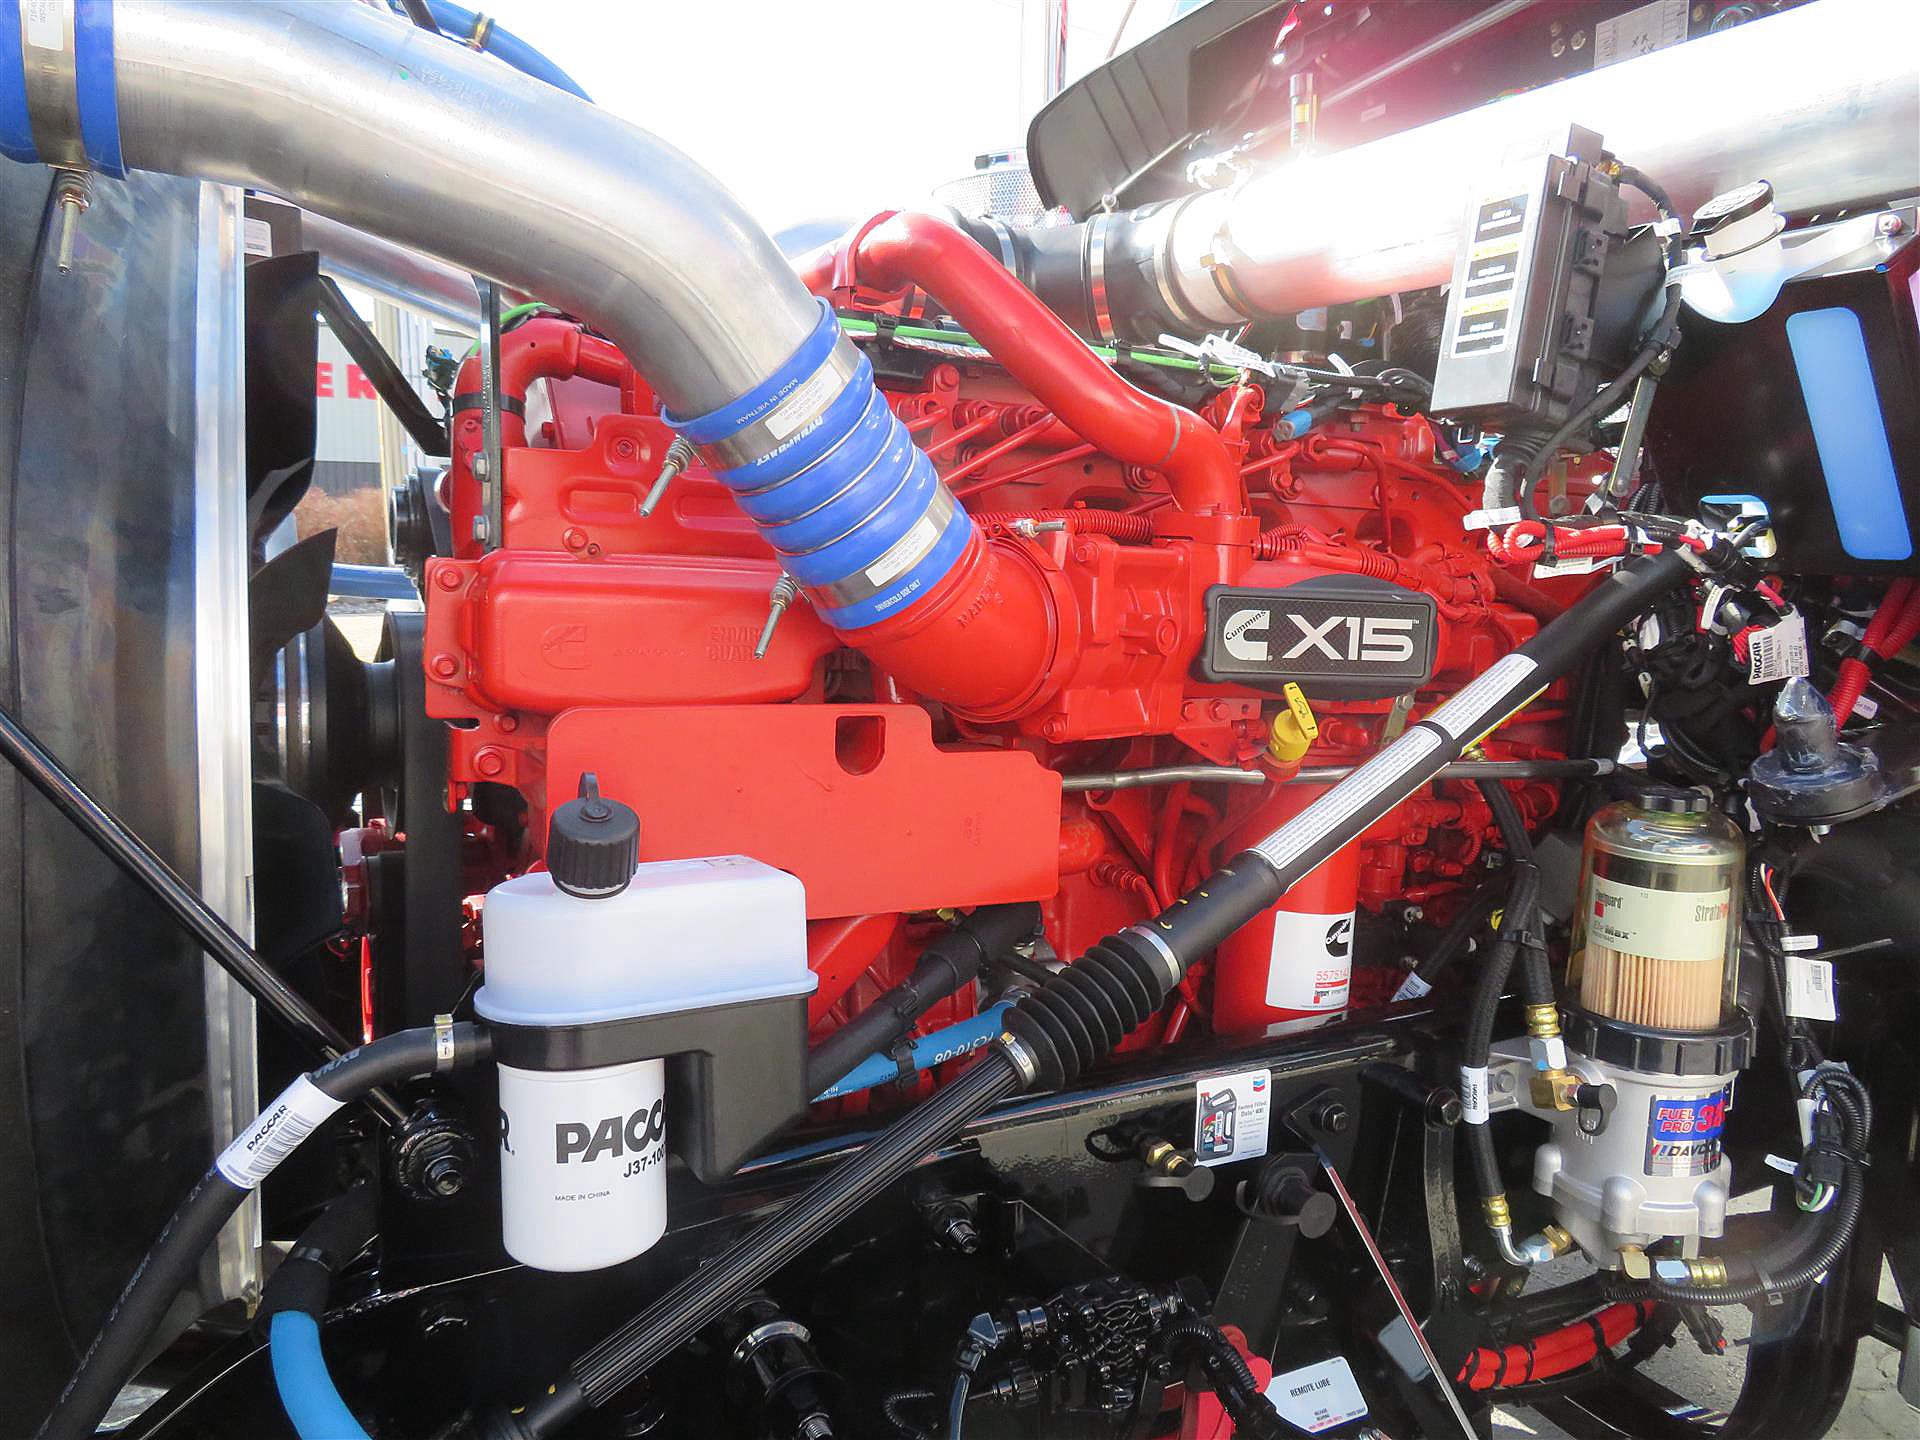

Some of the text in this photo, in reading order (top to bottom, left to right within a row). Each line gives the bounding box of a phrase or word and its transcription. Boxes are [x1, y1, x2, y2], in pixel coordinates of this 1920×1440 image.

[778, 378, 799, 397] MADE
[736, 400, 770, 425] VIETNAM
[1225, 610, 1414, 662] Cummins X15
[1751, 641, 1762, 680] PACCAR
[1657, 1107, 1695, 1121] FUEL
[245, 1104, 288, 1152] PACCAR
[1660, 1120, 1694, 1133] PRO
[555, 1190, 611, 1202] MADE IN CHINA
[1289, 1377, 1331, 1398] REMOTE LUBE
